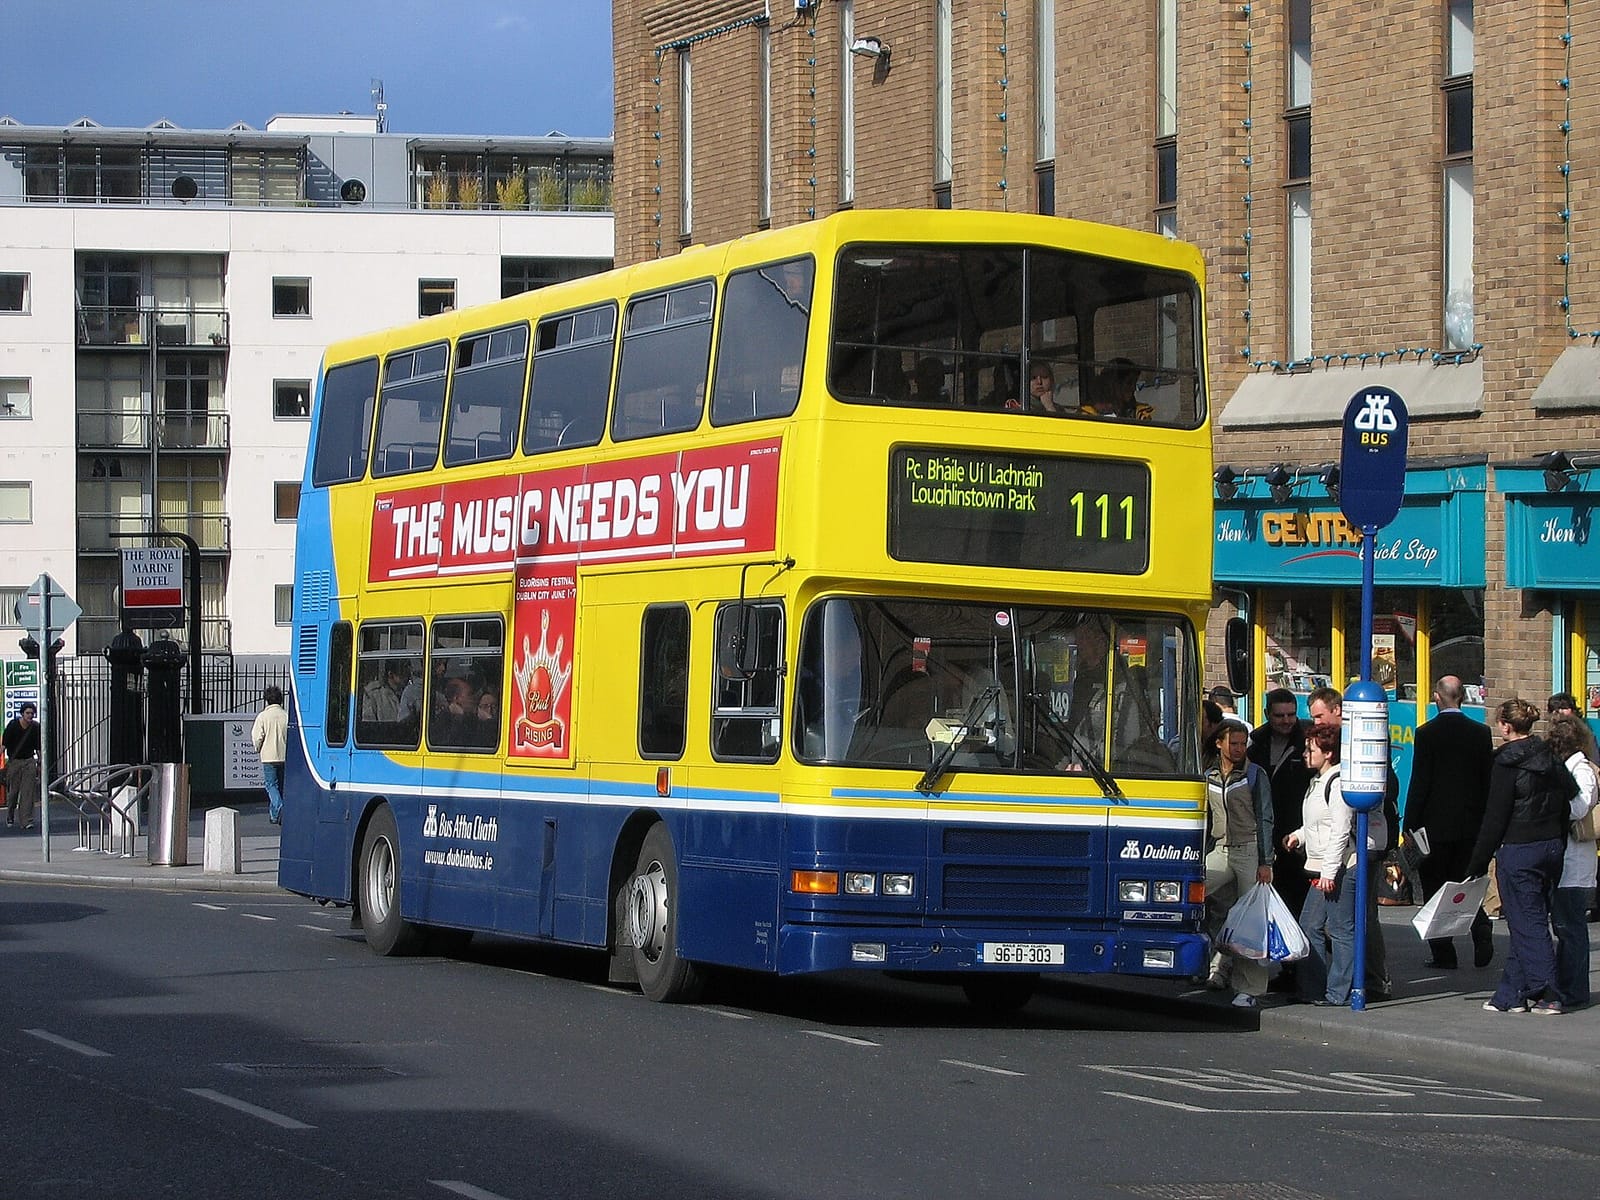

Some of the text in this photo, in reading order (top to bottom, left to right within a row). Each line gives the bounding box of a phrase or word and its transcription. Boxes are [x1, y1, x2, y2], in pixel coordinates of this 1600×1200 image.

[1361, 432, 1388, 445] BUS
[906, 457, 924, 480] Pc.
[969, 462, 984, 484] Uí
[989, 463, 1043, 488] Lachnáin
[911, 482, 1036, 511] Loughlinstown Park
[391, 463, 750, 560] THE MUSIC NEEDS YOU
[1070, 491, 1134, 540] 111
[1217, 518, 1252, 542] Ken's
[1540, 516, 1588, 543] Ken's
[124, 550, 181, 560] THE ROYAL
[1359, 538, 1438, 568] uick Stop
[132, 563, 173, 573] MARINE
[136, 576, 169, 586] HOTEL
[551, 576, 575, 586] FESTIVAL
[516, 591, 537, 601] DUBLIN
[538, 590, 550, 600] CITY
[551, 589, 566, 600] JUNE
[528, 690, 551, 713] Bud
[525, 726, 553, 743] RISING
[438, 812, 453, 838] Bus
[472, 815, 498, 842] Cliath
[424, 847, 494, 871] www.dublinbus.ie
[1142, 844, 1200, 861] Dublin Bus
[995, 947, 1051, 962] 96-D-303
[1077, 1064, 1543, 1103] BUS
